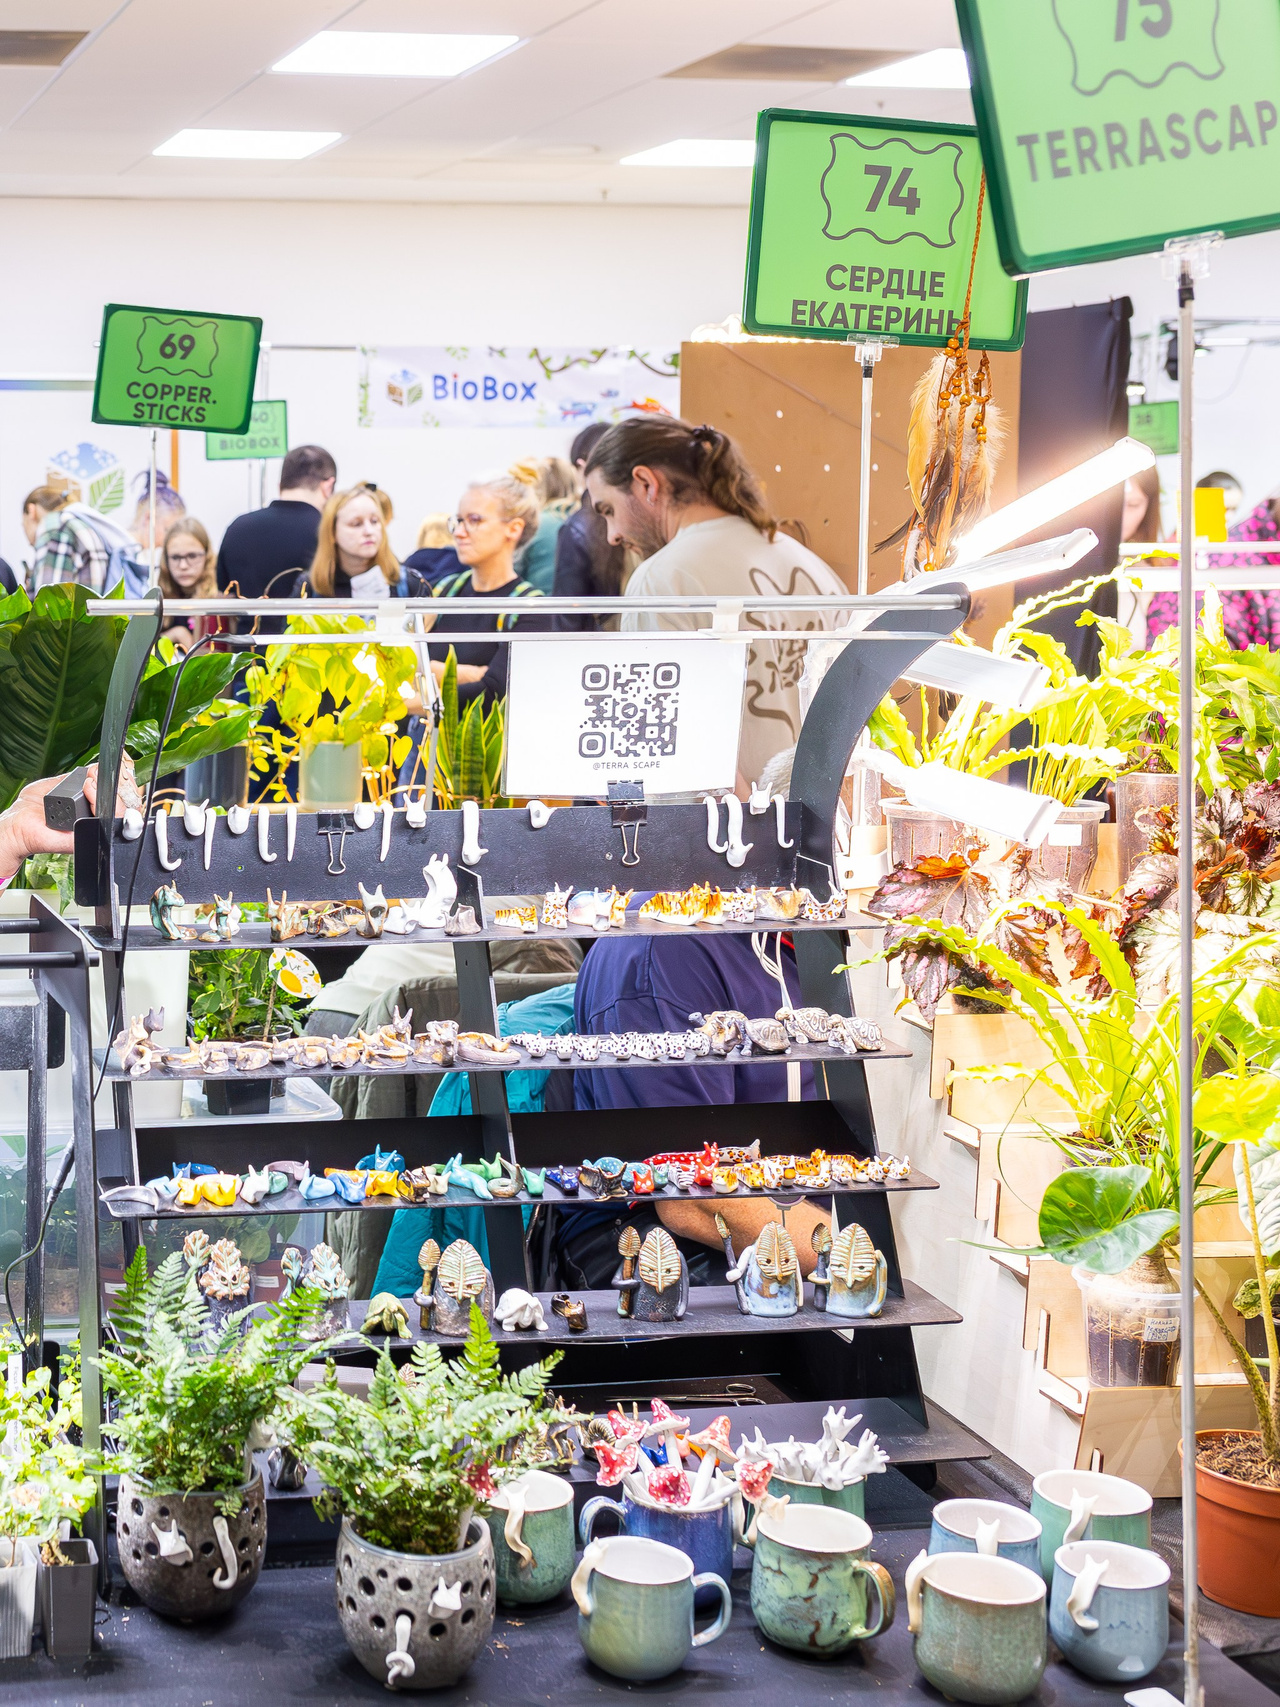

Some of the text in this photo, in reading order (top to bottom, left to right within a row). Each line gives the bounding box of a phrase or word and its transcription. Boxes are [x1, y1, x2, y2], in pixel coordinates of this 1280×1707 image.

[864, 164, 921, 216] 74
[825, 264, 946, 301] СЕРДЦЕ
[160, 333, 195, 360] 69
[126, 381, 217, 404] COPPER.
[433, 373, 537, 401] BioBox
[133, 402, 206, 423] STICKS
[220, 437, 280, 450] BIOBOX
[592, 761, 661, 770] @TERRA SCAPE
